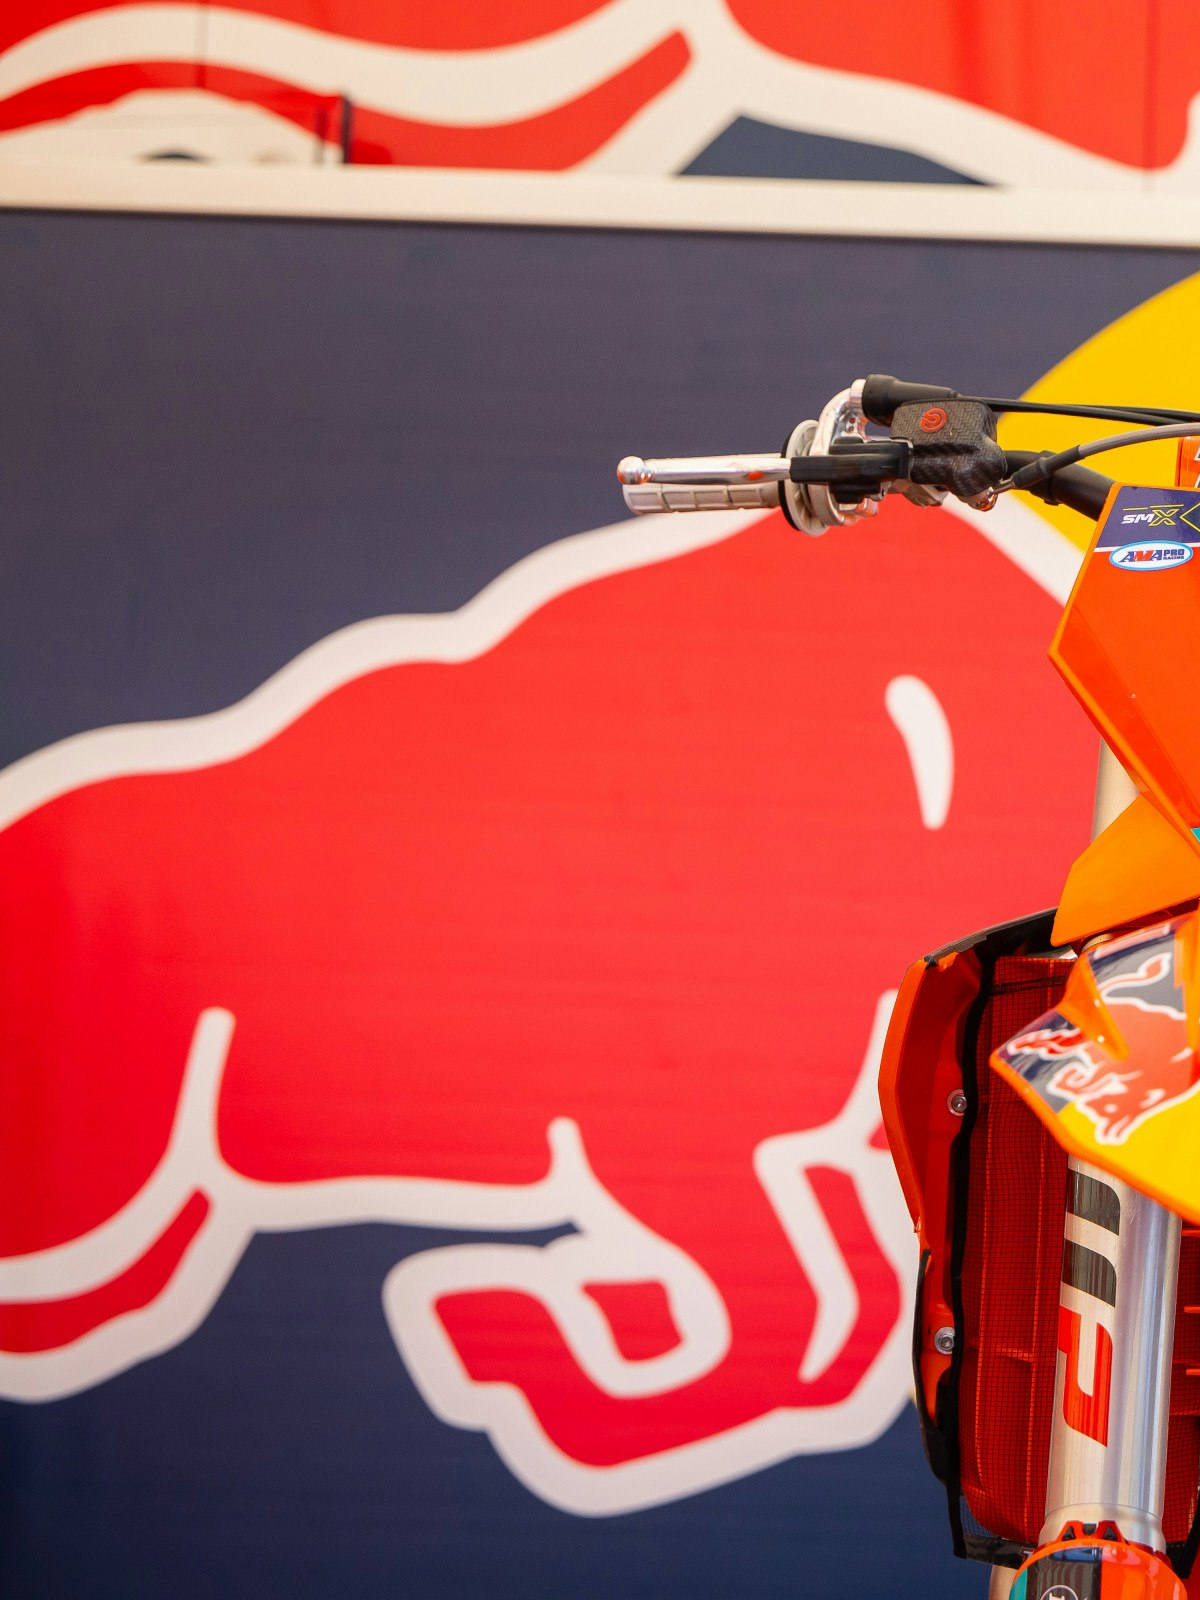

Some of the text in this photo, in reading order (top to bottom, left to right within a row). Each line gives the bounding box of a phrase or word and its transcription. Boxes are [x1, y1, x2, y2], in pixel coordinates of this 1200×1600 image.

[1121, 508, 1180, 527] SMX
[1119, 548, 1185, 562] AMA PRO
